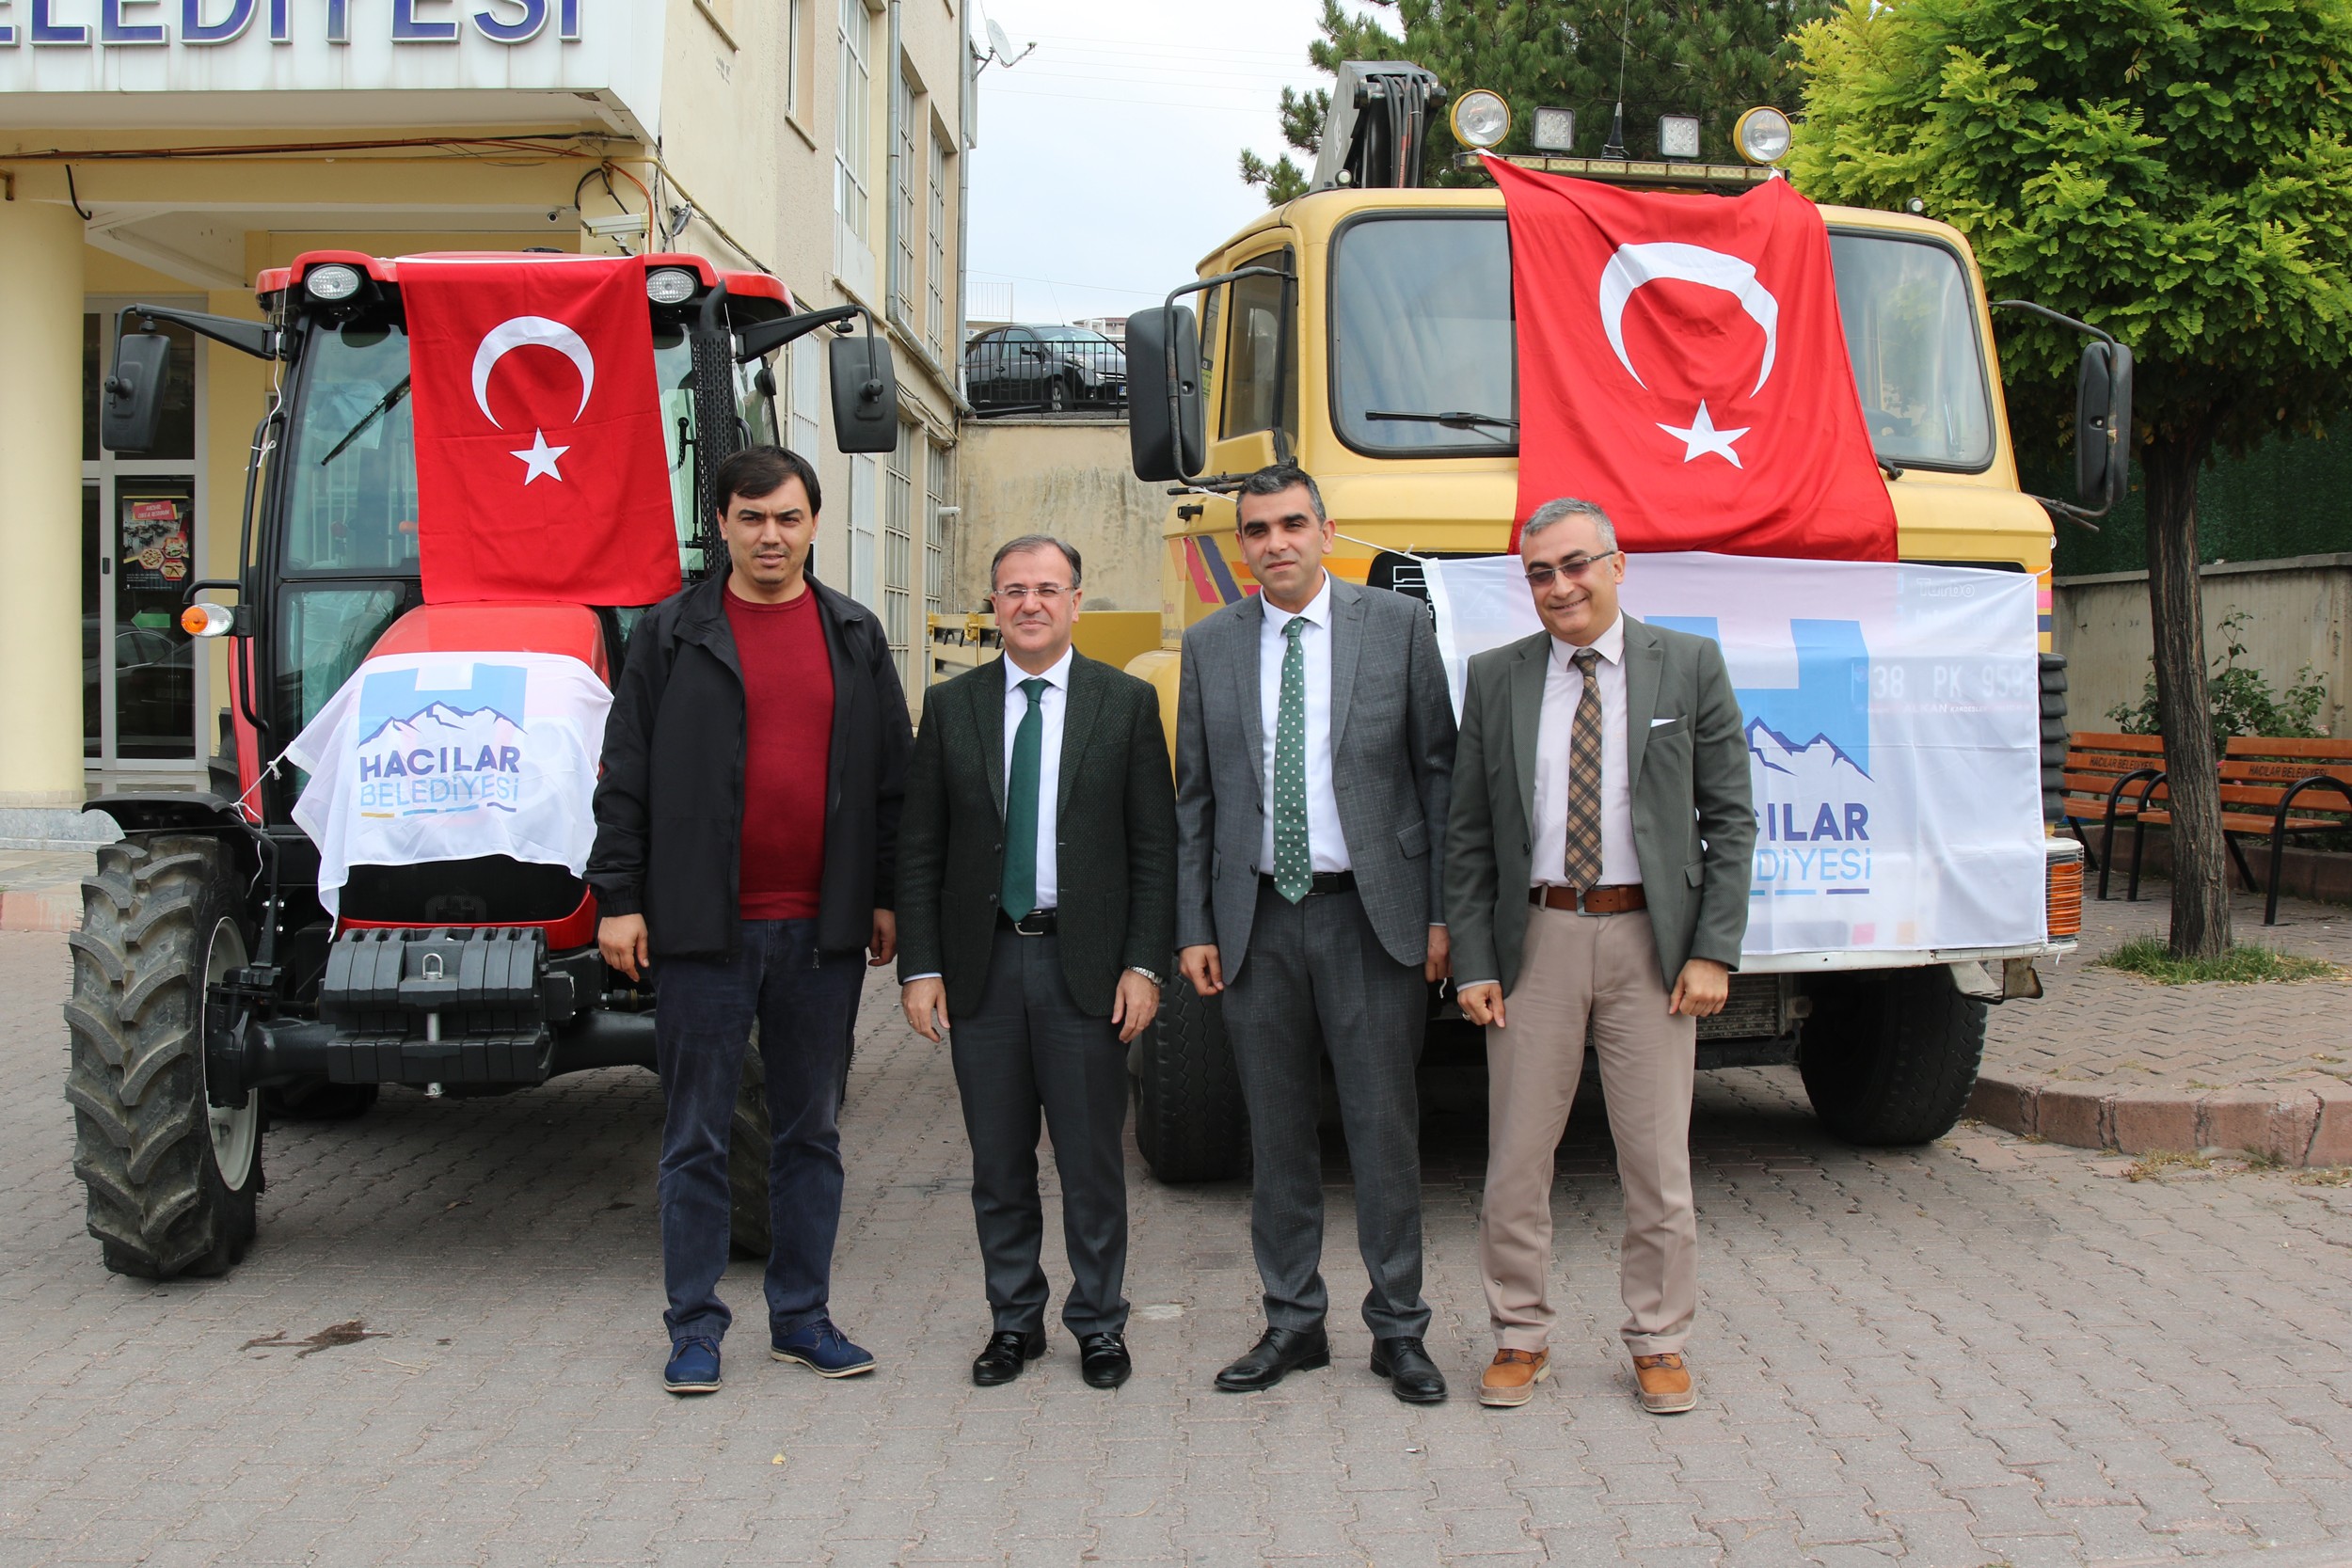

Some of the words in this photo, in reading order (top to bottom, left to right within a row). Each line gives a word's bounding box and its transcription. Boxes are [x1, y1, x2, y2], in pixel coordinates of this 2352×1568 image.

[1873, 665, 1904, 698] 38
[1933, 665, 1963, 698] PK
[359, 745, 520, 783] HACILAR
[1754, 802, 1870, 841] ILAR
[1756, 847, 1871, 881] DİYESİ
